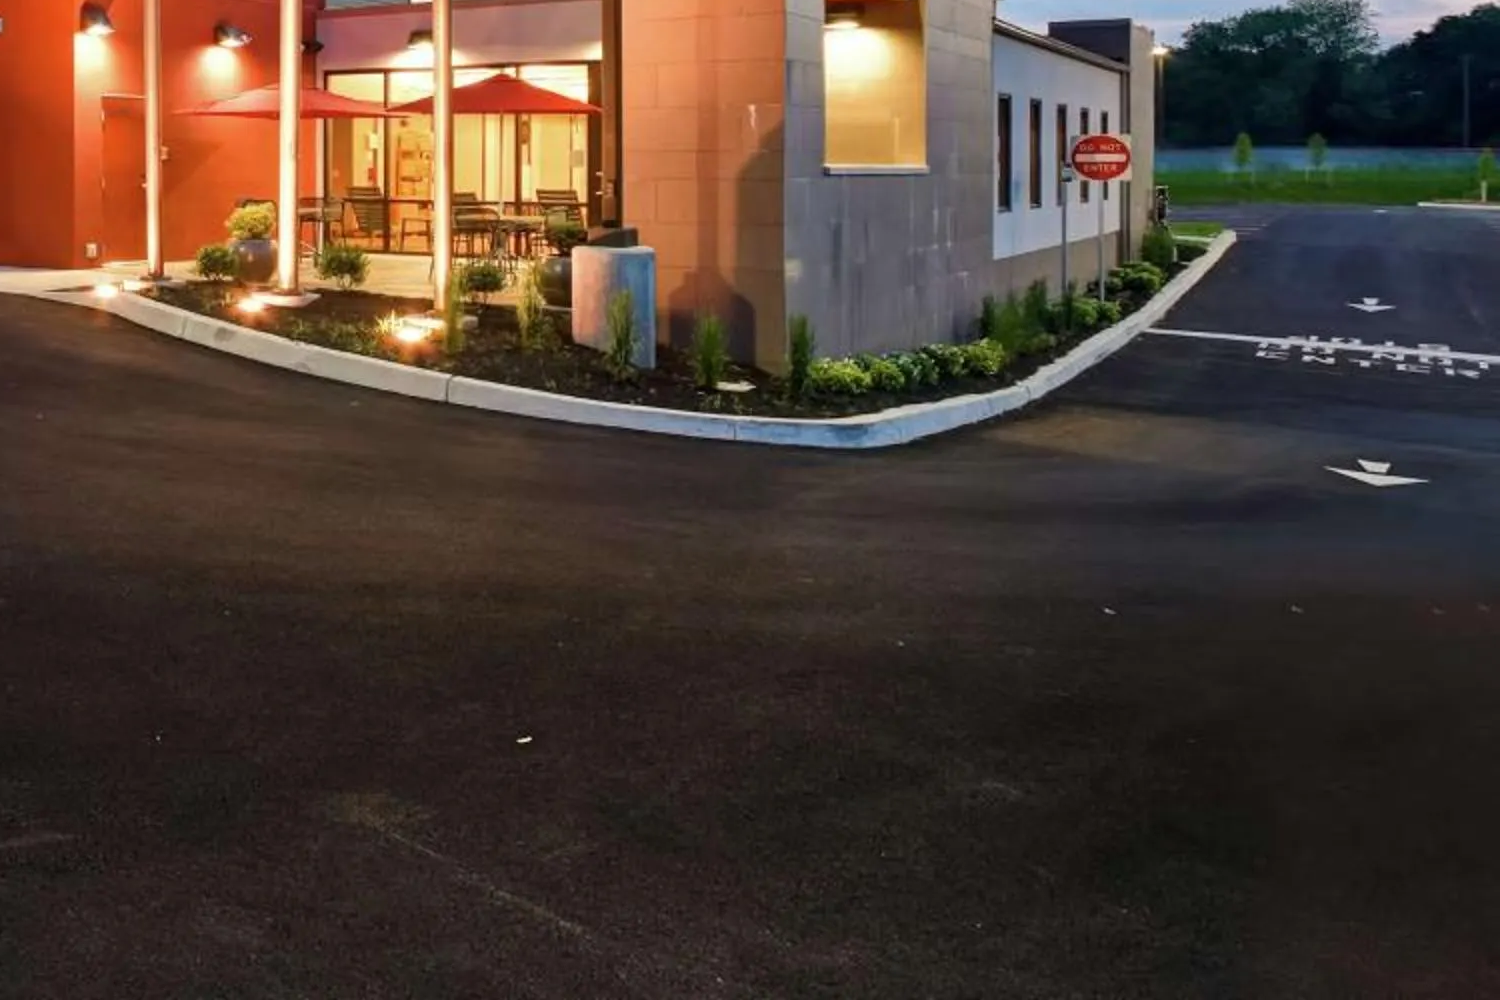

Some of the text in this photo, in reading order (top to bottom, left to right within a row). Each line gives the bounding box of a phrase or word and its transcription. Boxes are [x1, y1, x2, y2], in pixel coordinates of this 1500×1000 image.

[1079, 143, 1121, 151] DO NOT
[1083, 163, 1117, 172] ENTER
